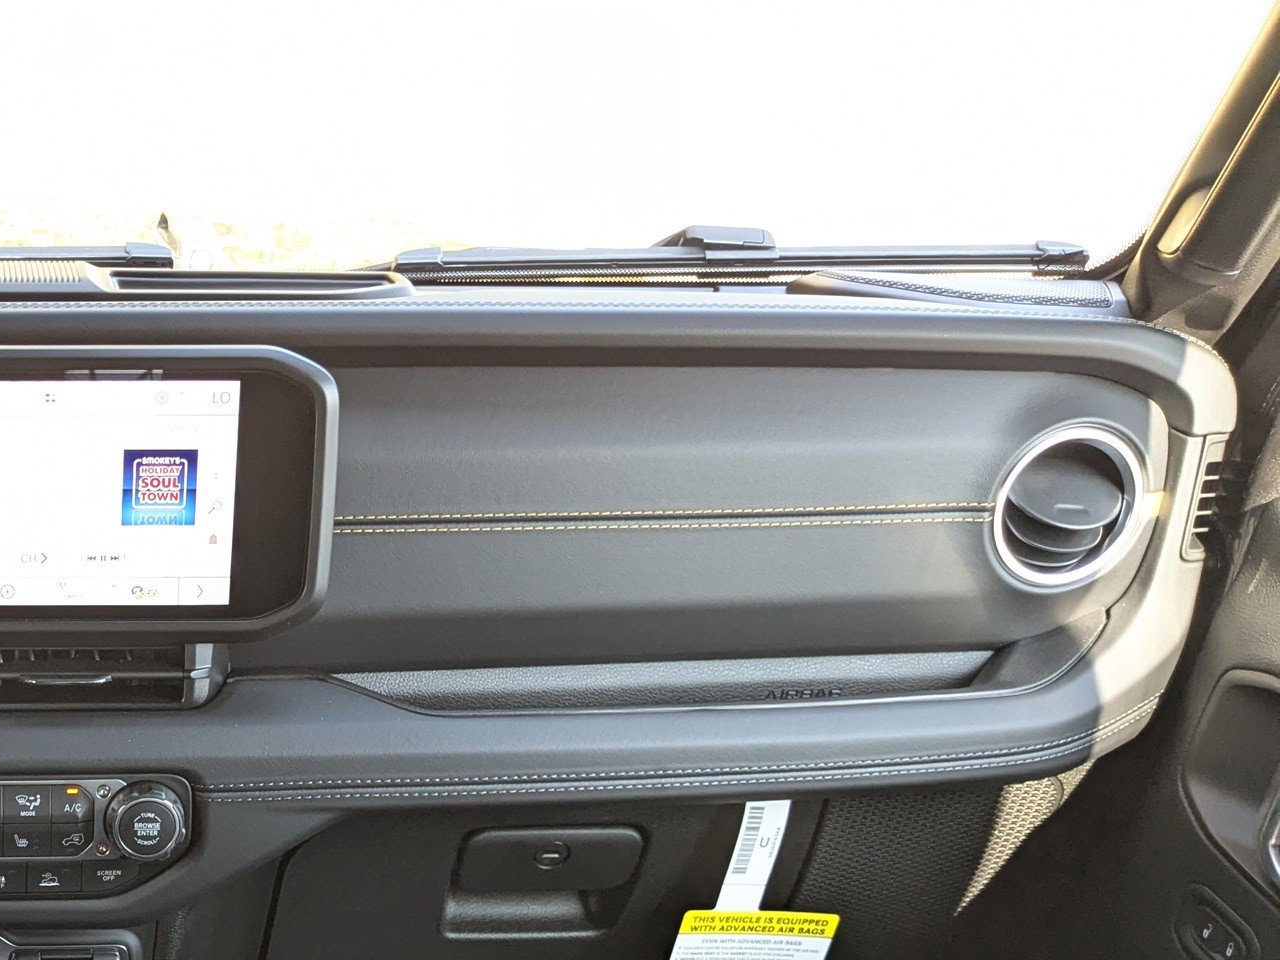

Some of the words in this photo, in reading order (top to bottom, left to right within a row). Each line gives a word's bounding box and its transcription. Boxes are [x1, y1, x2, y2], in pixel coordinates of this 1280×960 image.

[212, 391, 231, 404] LO
[140, 477, 180, 489] SOUL
[140, 492, 179, 501] TOWN
[64, 803, 82, 812] A/C
[136, 838, 158, 847] SCROLL
[693, 916, 716, 924] THIS
[720, 916, 761, 924] VEHICLE
[776, 917, 829, 927] EQUIPPED
[719, 925, 775, 933] ADVANCED
[777, 926, 794, 934] AIR
[797, 927, 826, 935] BAGS
